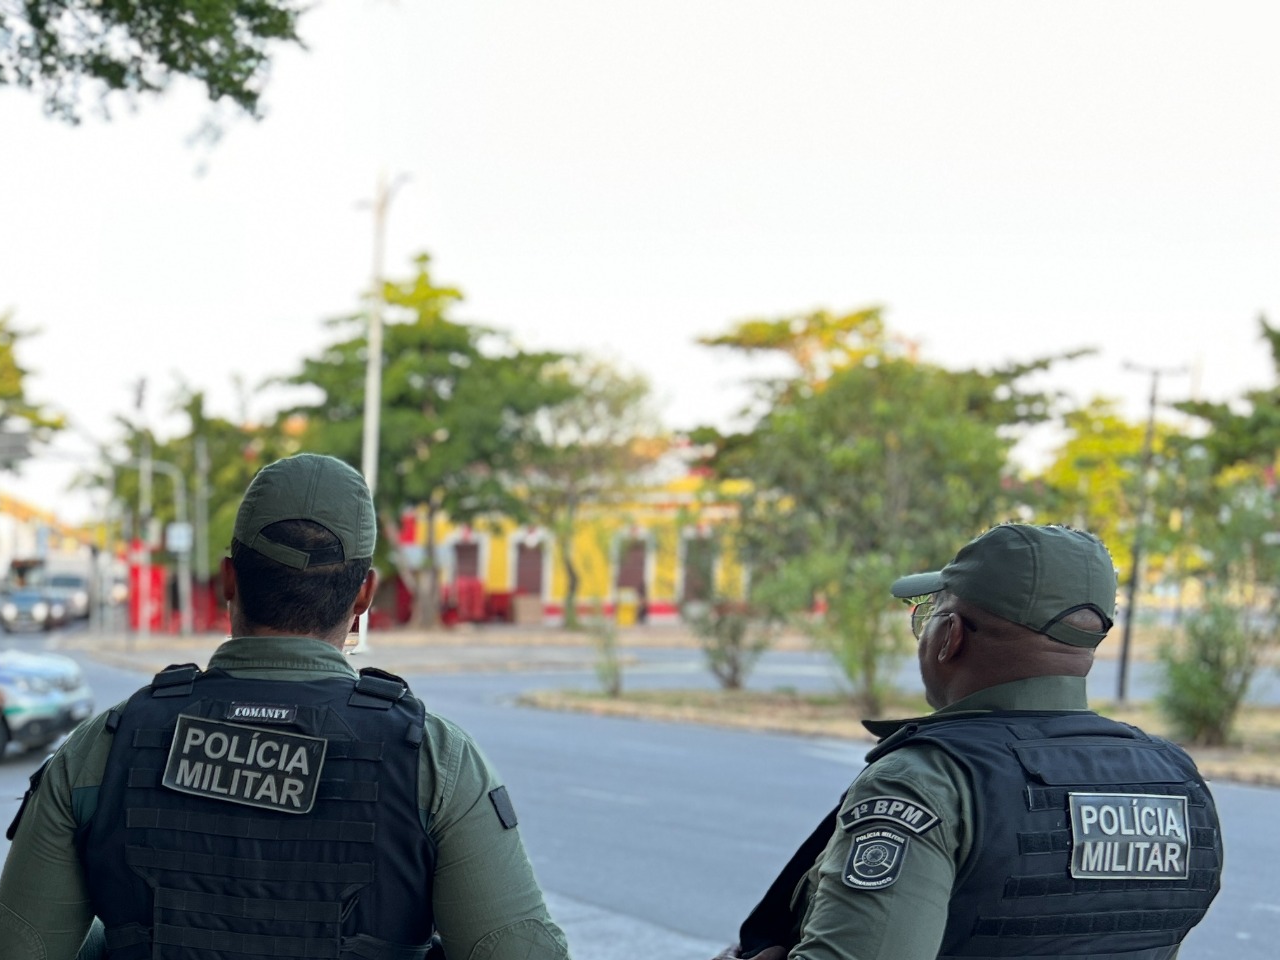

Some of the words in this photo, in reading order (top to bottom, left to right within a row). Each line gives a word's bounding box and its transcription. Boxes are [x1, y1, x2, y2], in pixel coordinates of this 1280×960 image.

[182, 727, 309, 776] POLÍCIA
[175, 758, 304, 808] MILITAR
[873, 800, 923, 825] BPM
[1080, 799, 1182, 836] POLÍCIA
[1081, 841, 1180, 872] MILITAR
